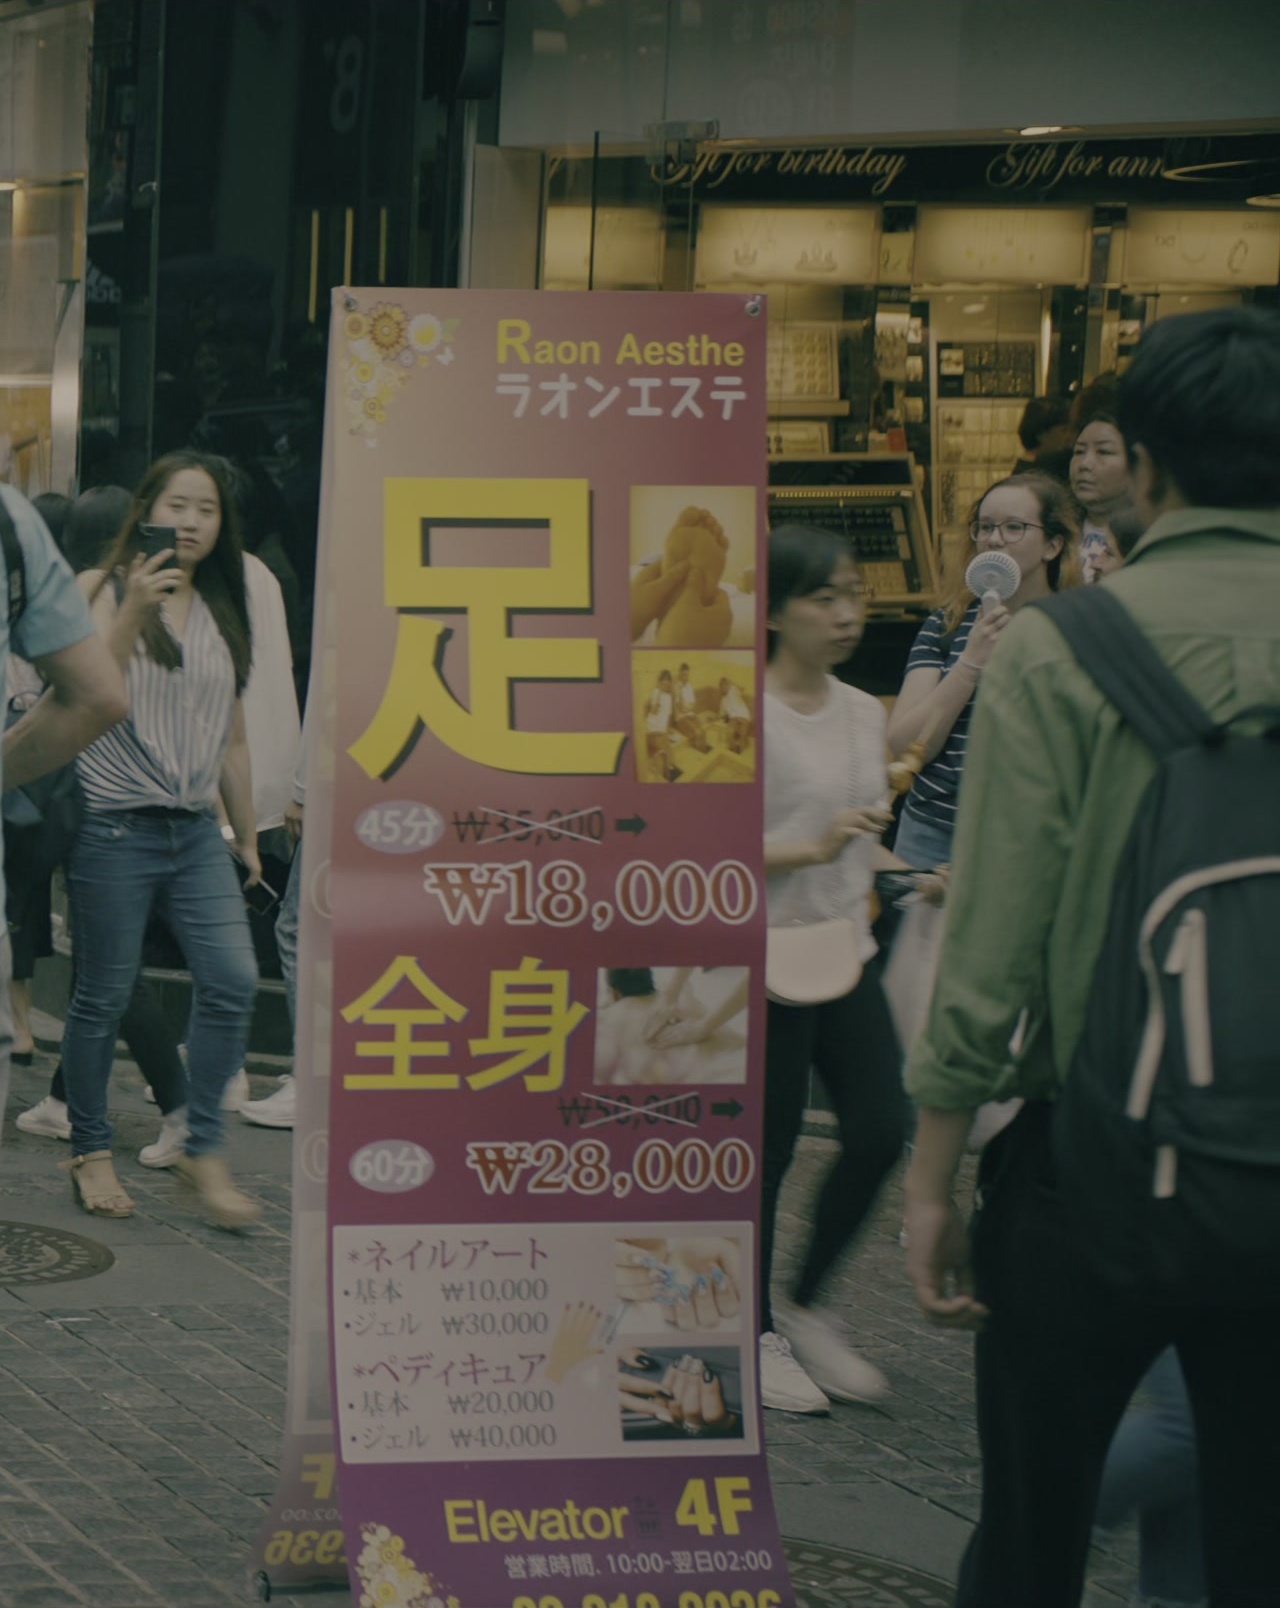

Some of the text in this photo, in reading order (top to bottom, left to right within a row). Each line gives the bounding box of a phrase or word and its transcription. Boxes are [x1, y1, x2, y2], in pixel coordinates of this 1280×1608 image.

[776, 147, 908, 195] birthday
[986, 142, 1063, 190] Gift
[1042, 140, 1104, 190] for
[496, 318, 746, 367] Raon Aesthe
[495, 372, 747, 420] ラオンエステ
[345, 476, 629, 782] 足
[357, 806, 440, 848] 45分
[422, 858, 759, 933] ₩18,000
[339, 955, 592, 1093] 全身
[351, 1146, 432, 1187] 60分
[466, 1137, 757, 1199] ₩28,000
[441, 1277, 549, 1302] ₩10,000
[442, 1311, 549, 1337] ₩30,000
[448, 1389, 555, 1415] ₩20,000
[450, 1423, 557, 1450] ₩40,000
[444, 1476, 754, 1544] Elevator 4F
